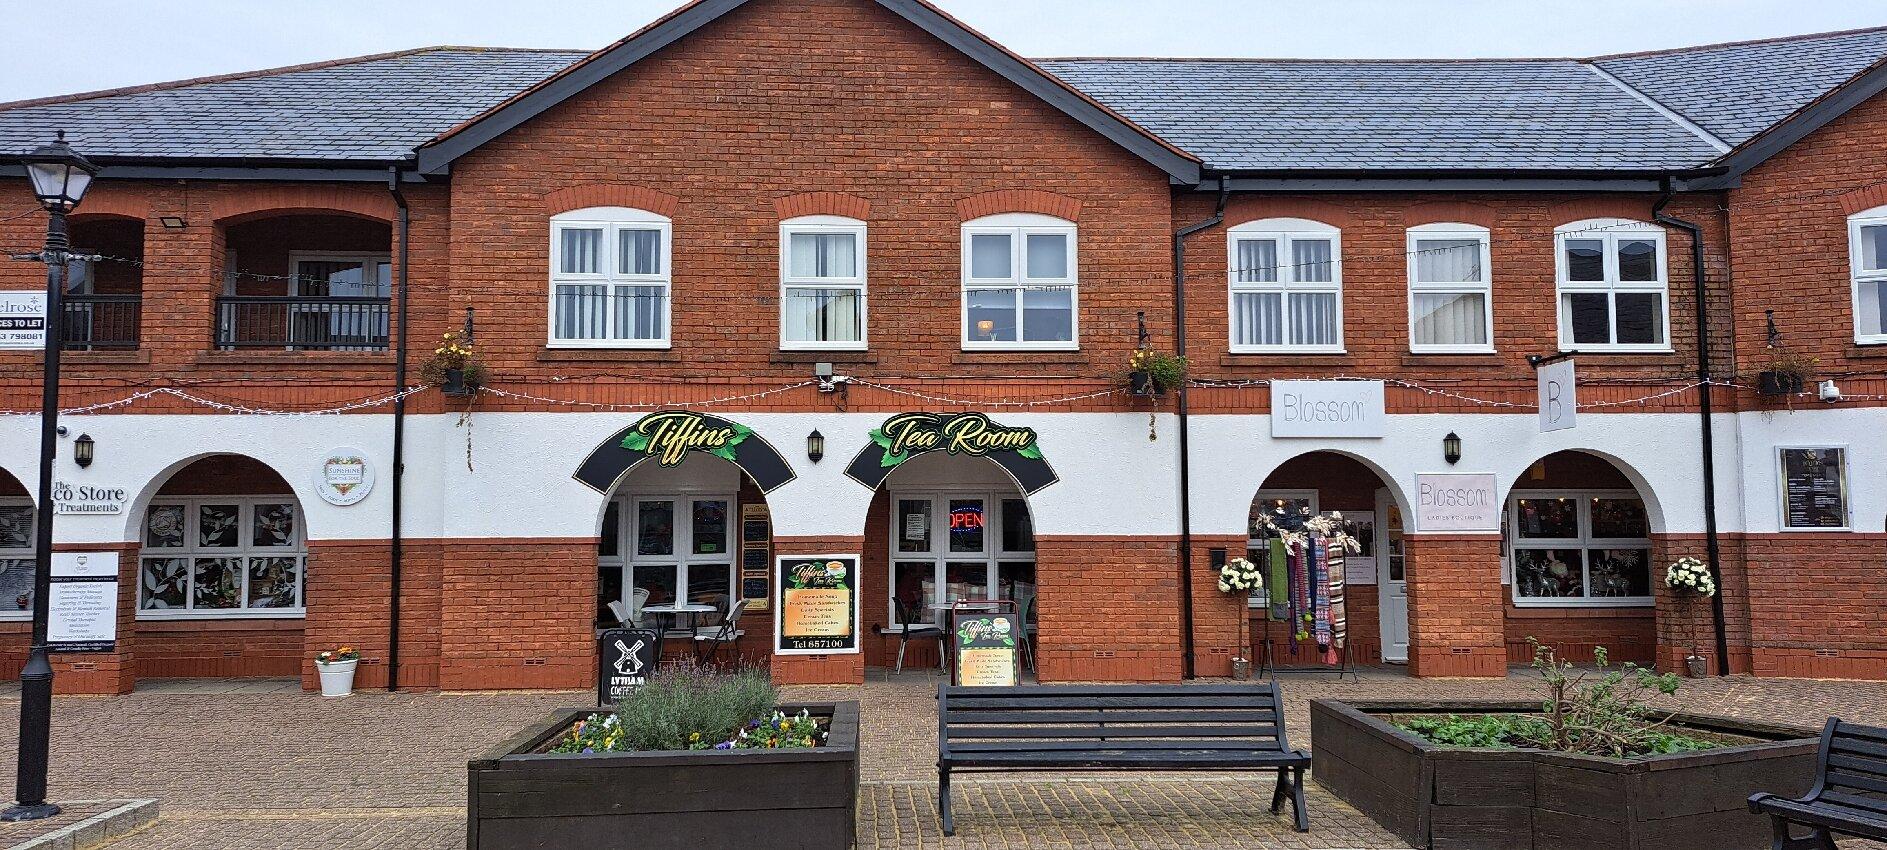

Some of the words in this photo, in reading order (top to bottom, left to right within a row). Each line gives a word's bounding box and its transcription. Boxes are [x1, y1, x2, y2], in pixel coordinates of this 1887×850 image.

[15, 319, 26, 328] TO
[27, 319, 42, 328] LET
[1284, 393, 1365, 422] Blossom
[1548, 380, 1562, 424] B
[637, 412, 733, 465] Tiffins
[885, 414, 942, 454] Tea
[944, 414, 1035, 454] Room
[79, 486, 124, 500] Store
[1420, 483, 1488, 506] Blossom
[58, 503, 119, 512] Treatments
[949, 513, 984, 528] OPEN
[792, 563, 827, 584] Tiffins
[961, 620, 993, 639] Tiffins
[793, 640, 806, 649] Tel
[808, 640, 843, 649] 857100
